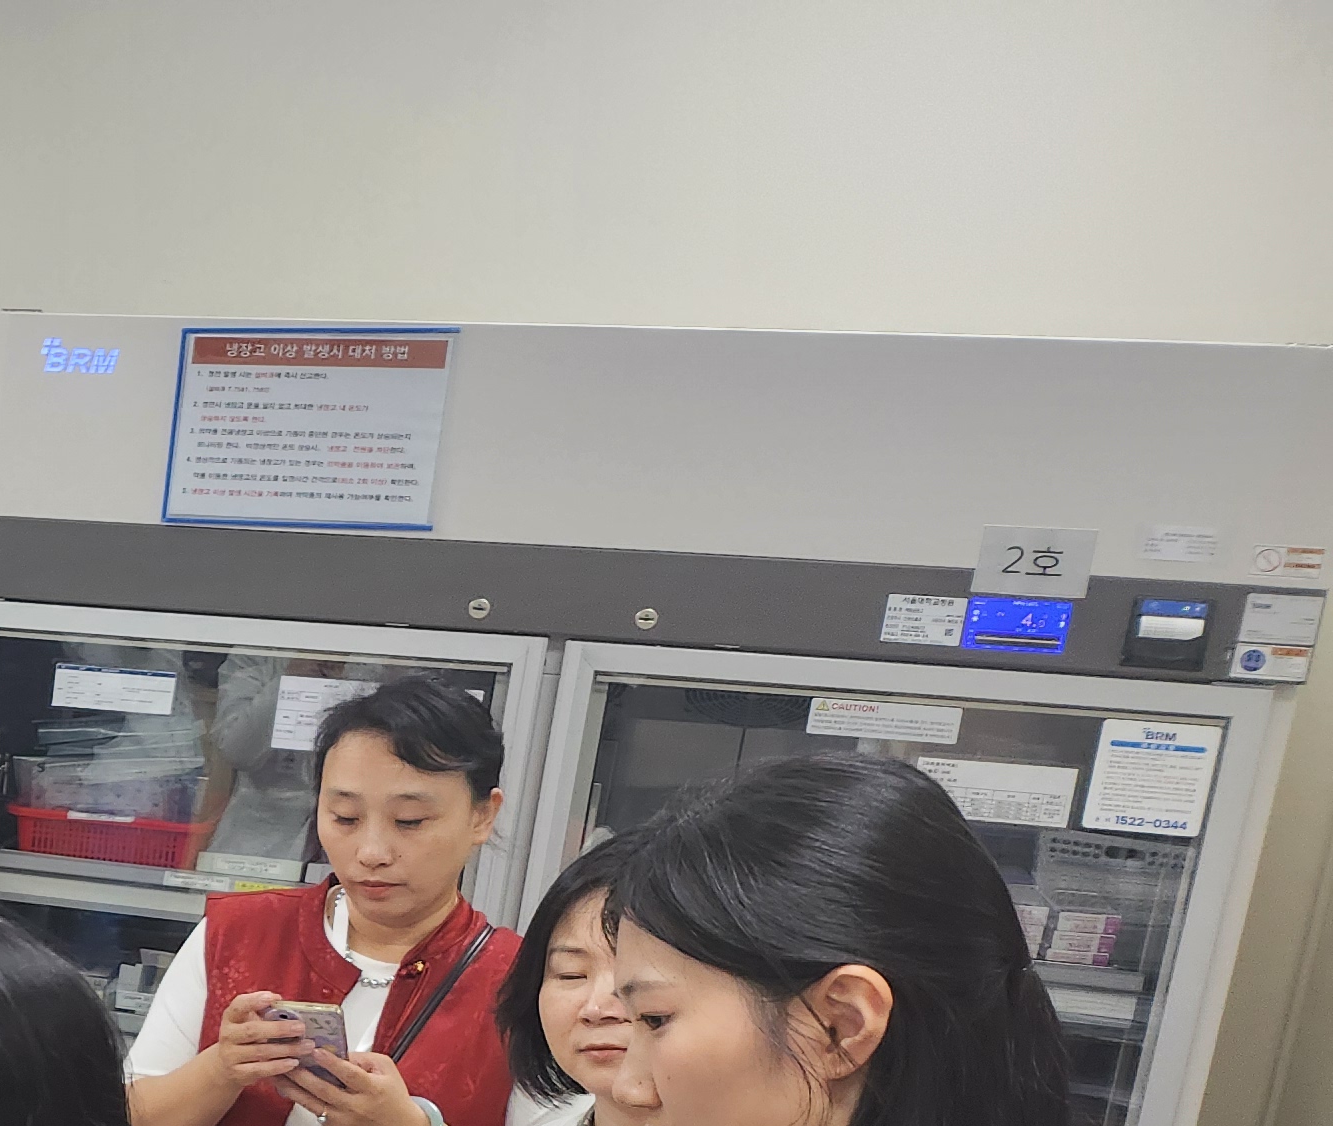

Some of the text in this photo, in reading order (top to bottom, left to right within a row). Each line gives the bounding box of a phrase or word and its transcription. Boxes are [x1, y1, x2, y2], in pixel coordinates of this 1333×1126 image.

[226, 343, 409, 360] 냉장고 이상 발생시 대처 방법
[43, 345, 121, 375] BRM
[1002, 546, 1064, 576] 2호
[831, 702, 879, 713] CAUTION!
[1144, 731, 1177, 742] BRM
[1115, 815, 1188, 830] 1522-0344
